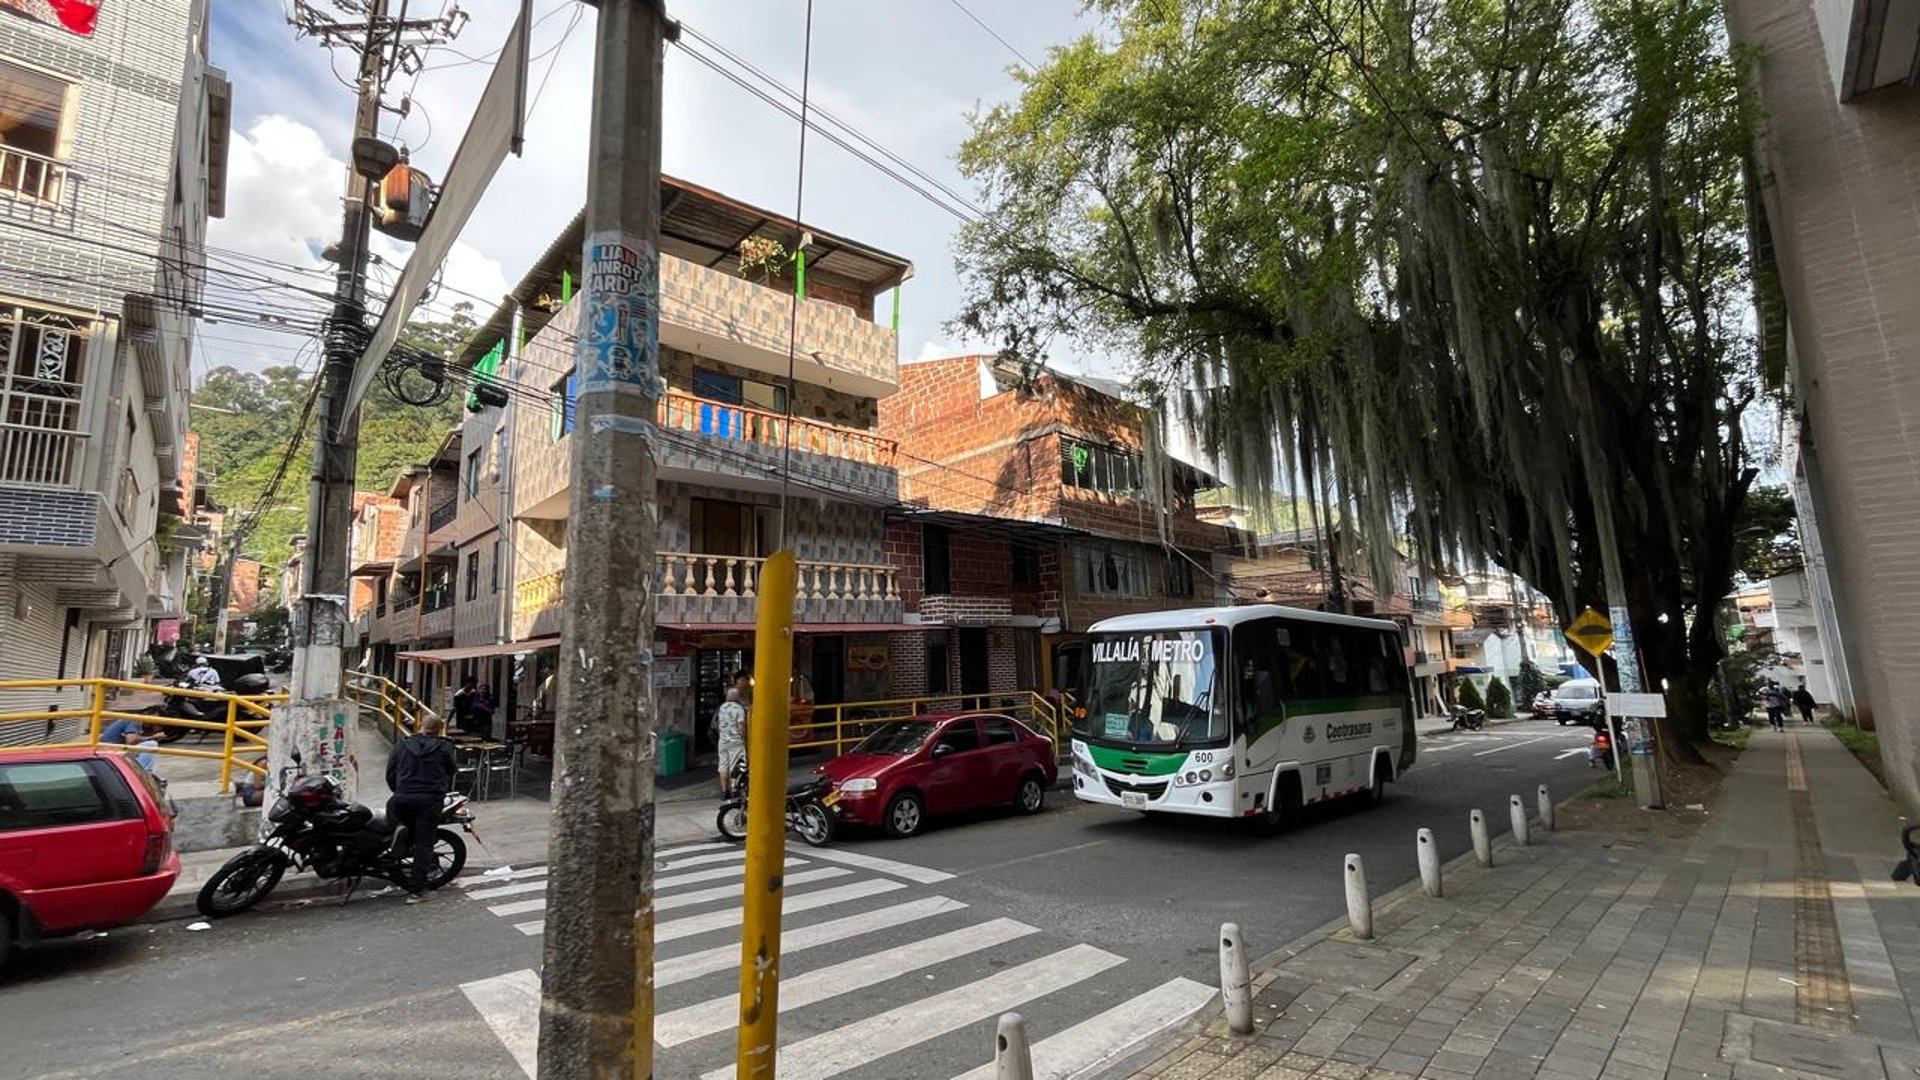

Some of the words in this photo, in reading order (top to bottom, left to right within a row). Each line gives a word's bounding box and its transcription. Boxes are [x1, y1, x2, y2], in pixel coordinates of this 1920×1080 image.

[1092, 637, 1140, 662] VILLALÍA
[1151, 640, 1204, 662] METRO
[1195, 752, 1213, 763] 600
